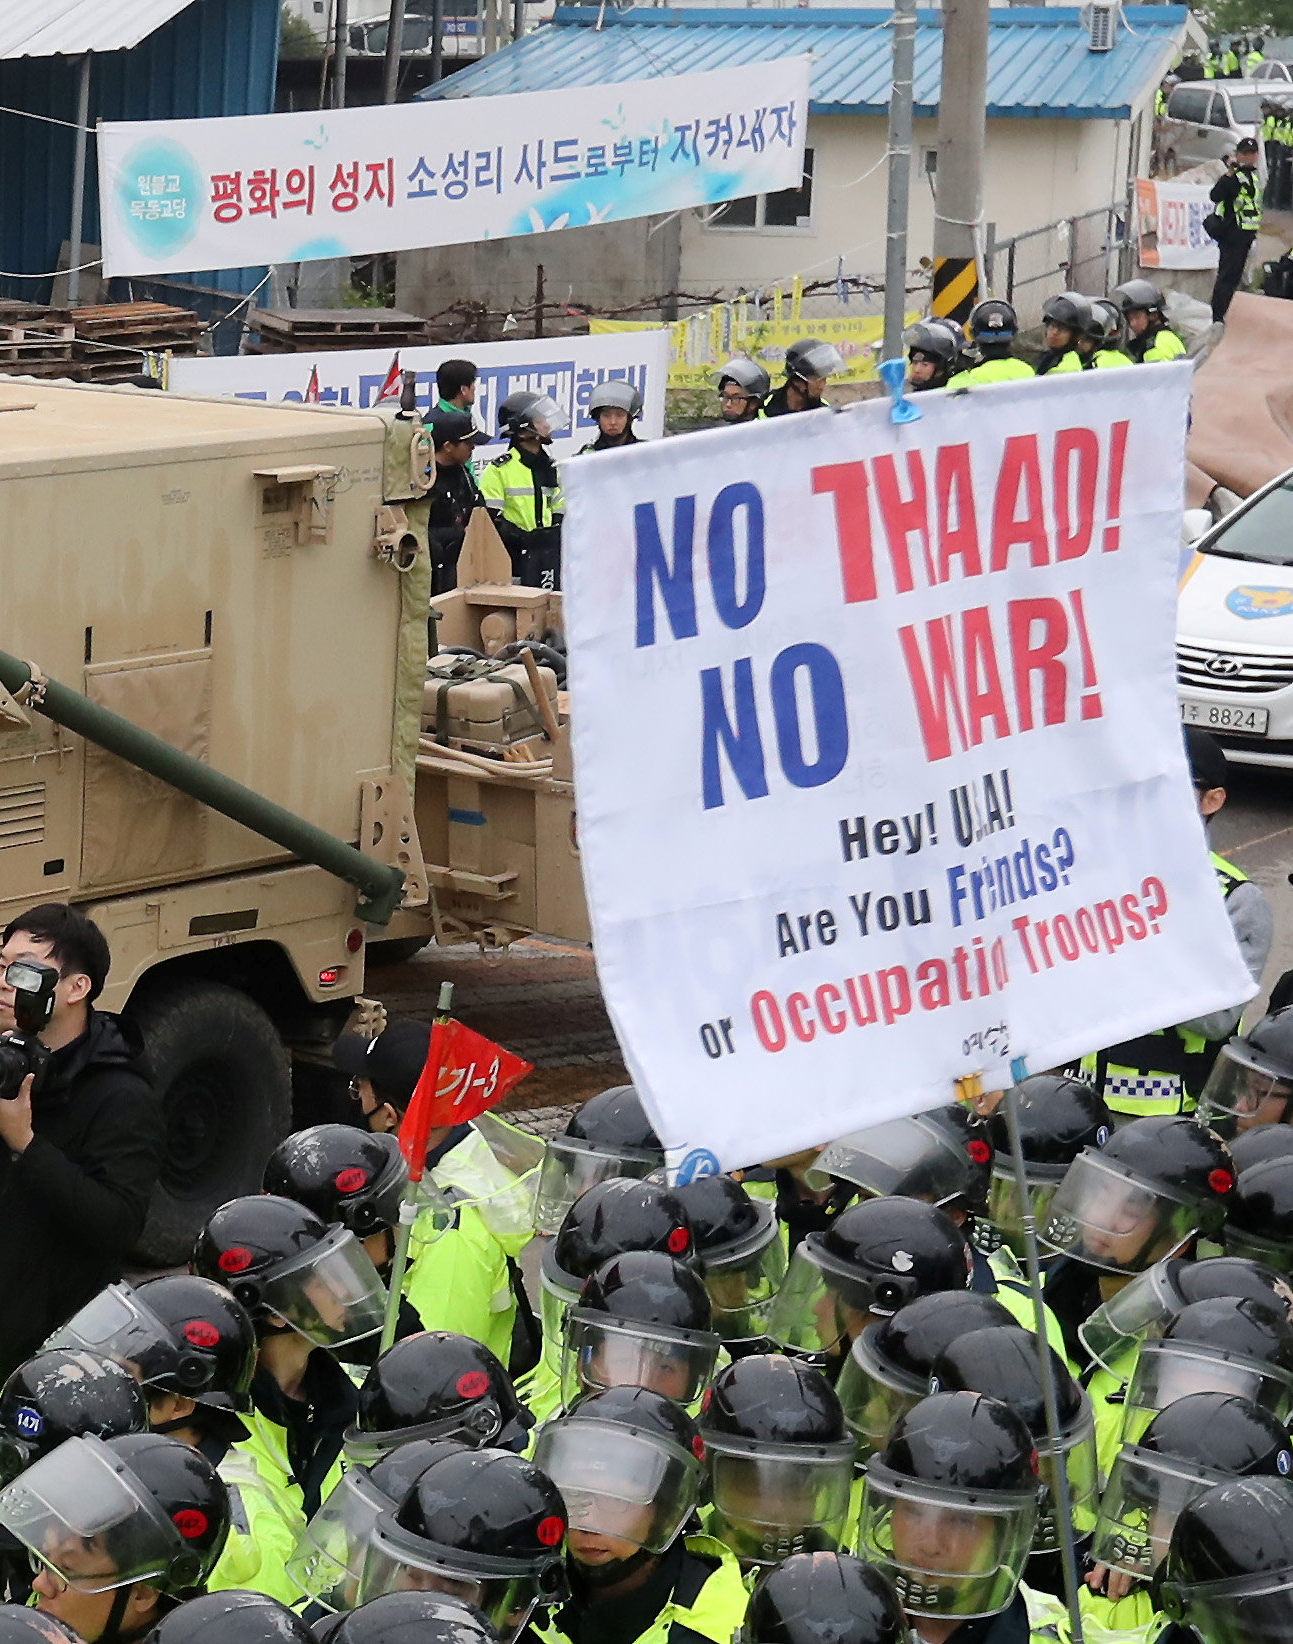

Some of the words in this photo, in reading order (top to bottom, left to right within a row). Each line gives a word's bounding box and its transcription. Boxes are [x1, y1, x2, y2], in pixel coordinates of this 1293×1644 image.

[137, 174, 181, 197] 원불교
[210, 164, 316, 224] 평화의
[328, 157, 395, 214] 성지
[406, 146, 504, 201] 소성리
[514, 136, 662, 191] 사드로부터
[670, 100, 797, 167] 지켜내자
[129, 199, 187, 220] 목동교당
[634, 481, 767, 649] NO
[811, 420, 1130, 604] THAAD!
[700, 642, 850, 811] NO
[897, 588, 1103, 763] WAR!
[1209, 707, 1256, 729] 8824
[838, 802, 939, 863] Hey!
[776, 909, 838, 958] Are
[848, 888, 932, 938] You
[698, 1017, 737, 1060] or
[1011, 876, 1167, 975] Troops?
